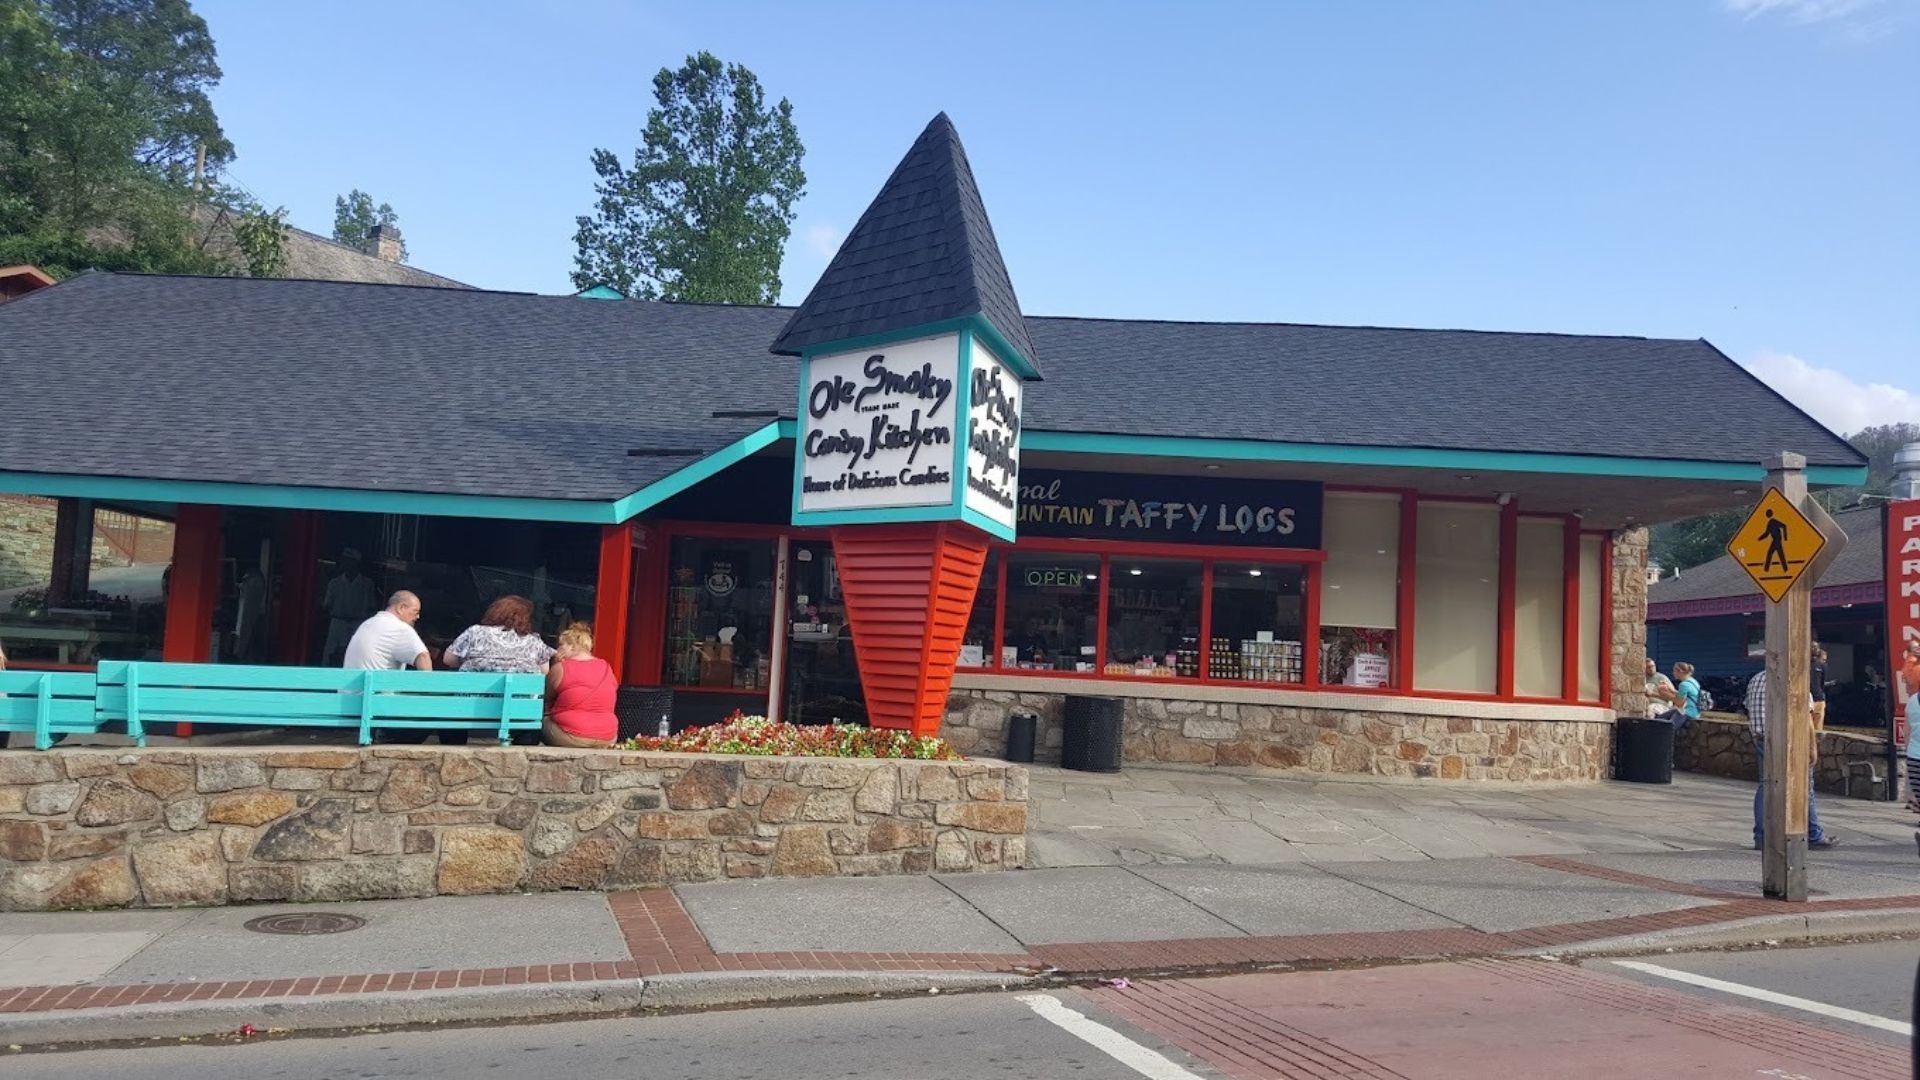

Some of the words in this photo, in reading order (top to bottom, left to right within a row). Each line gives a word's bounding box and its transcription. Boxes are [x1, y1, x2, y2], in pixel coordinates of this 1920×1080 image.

[809, 375, 856, 419] Ole
[854, 354, 952, 418] Smoky
[804, 428, 864, 470] Candy
[863, 409, 950, 465] Kitchen
[803, 475, 831, 493] Home
[832, 473, 847, 490] of
[848, 470, 897, 489] Delicious
[899, 465, 950, 485] Candies
[1098, 499, 1207, 532] TAFFY
[1217, 503, 1295, 534] LOGS
[1028, 571, 1081, 585] OPEN
